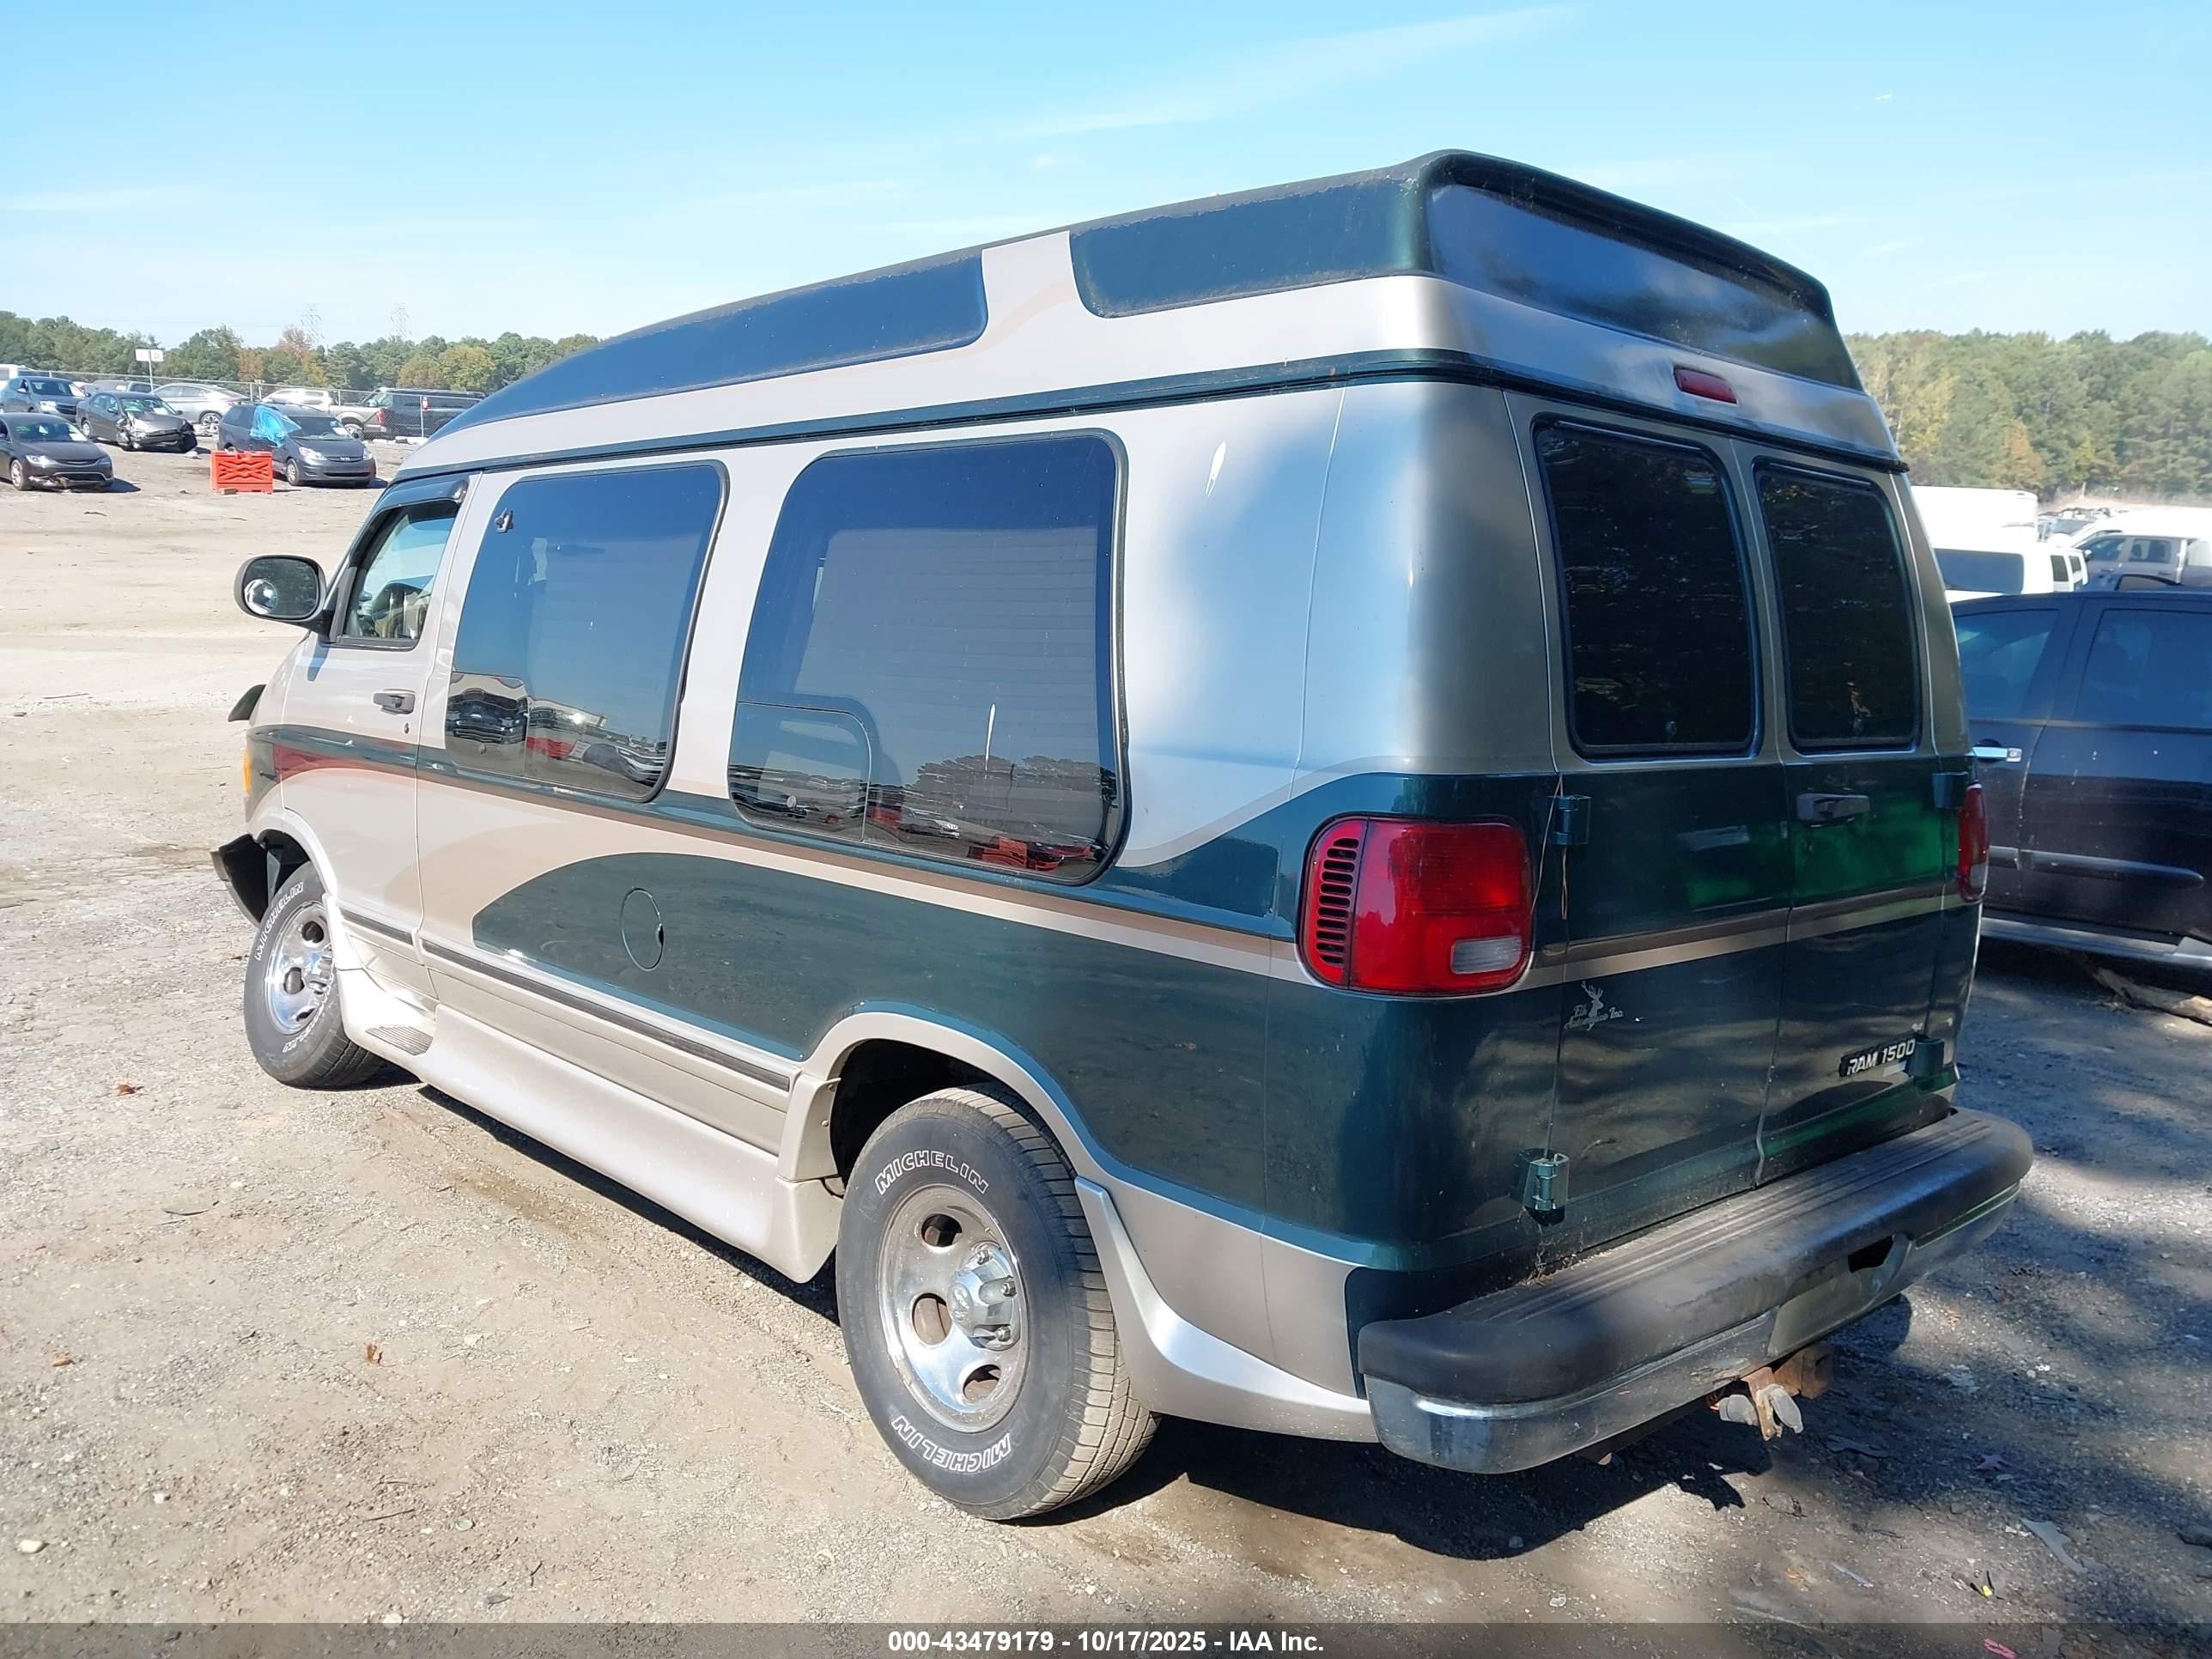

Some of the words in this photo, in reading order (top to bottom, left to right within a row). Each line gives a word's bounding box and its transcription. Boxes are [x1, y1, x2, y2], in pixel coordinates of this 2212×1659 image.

[1846, 1051, 1879, 1076] RAM
[1881, 1038, 1916, 1064] 1500
[874, 1150, 989, 1195] MICHELIN
[890, 1414, 1012, 1472] MICHELIN
